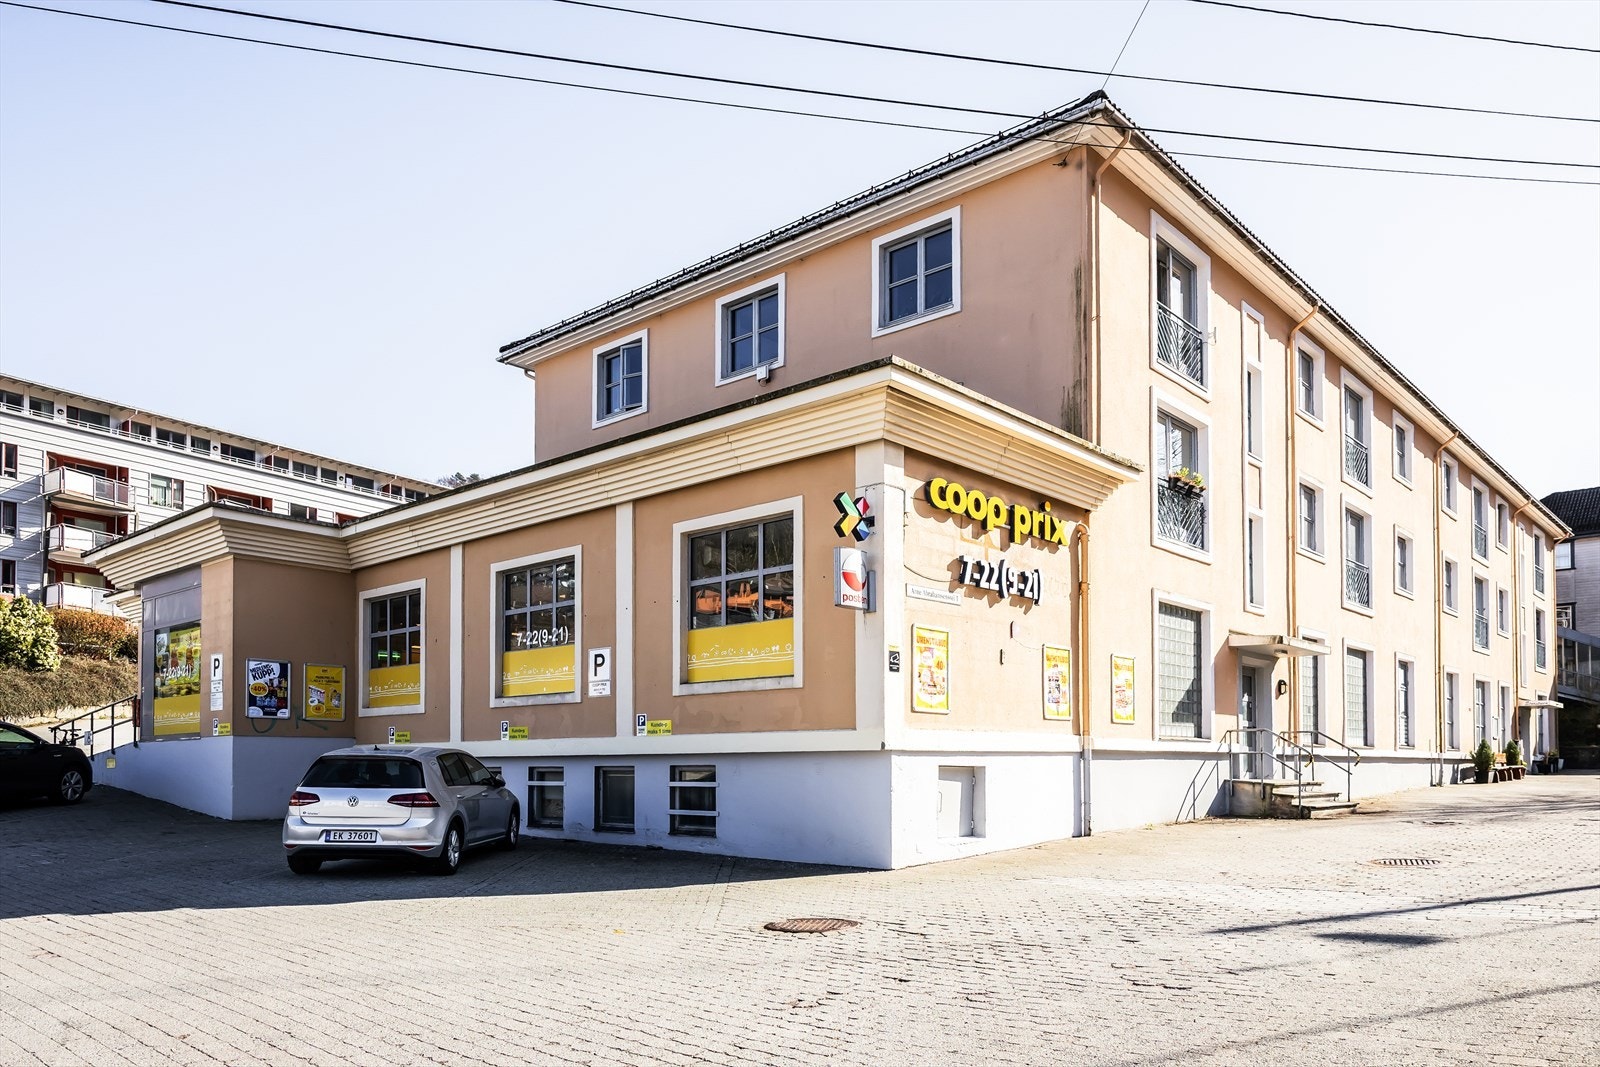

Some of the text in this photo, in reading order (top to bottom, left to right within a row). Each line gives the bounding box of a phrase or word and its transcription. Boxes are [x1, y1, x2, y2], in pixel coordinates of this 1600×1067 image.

[929, 477, 1069, 546] coop prix
[516, 626, 569, 647] 7-22(9-21)
[213, 658, 220, 677] P
[594, 653, 606, 677] P
[251, 668, 276, 681] KUPP!
[503, 723, 508, 731] P
[639, 716, 645, 726] P
[333, 832, 373, 840] EK 37601
